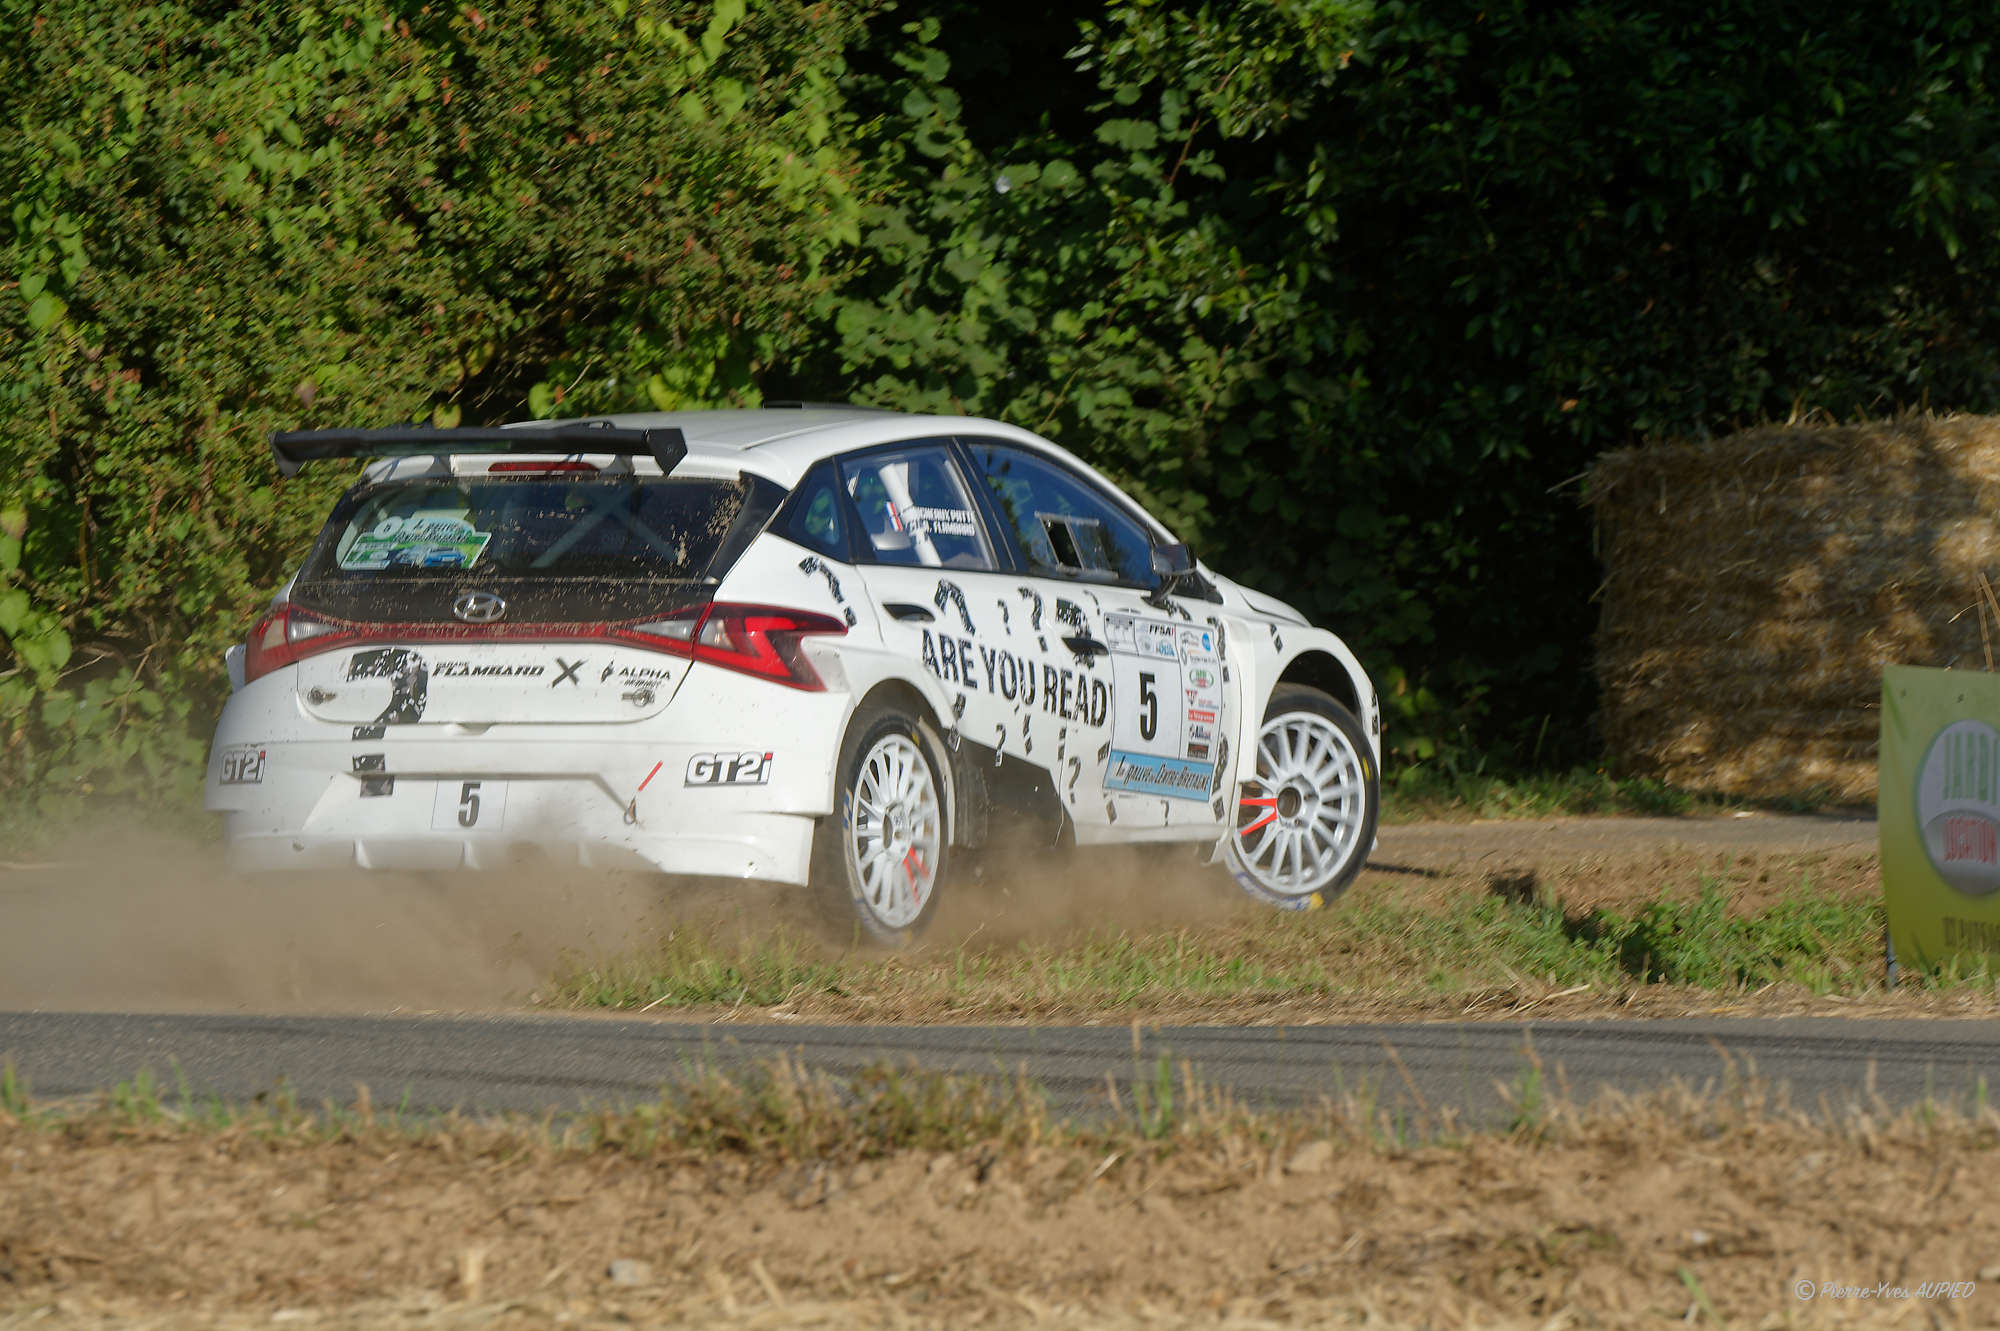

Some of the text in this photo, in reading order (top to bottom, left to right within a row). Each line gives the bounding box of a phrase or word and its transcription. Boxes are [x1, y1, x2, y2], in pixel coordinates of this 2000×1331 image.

[619, 667, 671, 680] ALPHA
[922, 629, 978, 689] ARE
[979, 645, 1036, 706] YOU
[1138, 671, 1158, 741] 5
[220, 749, 267, 785] GT2i
[684, 751, 774, 787] GT2i
[457, 781, 482, 828] 5
